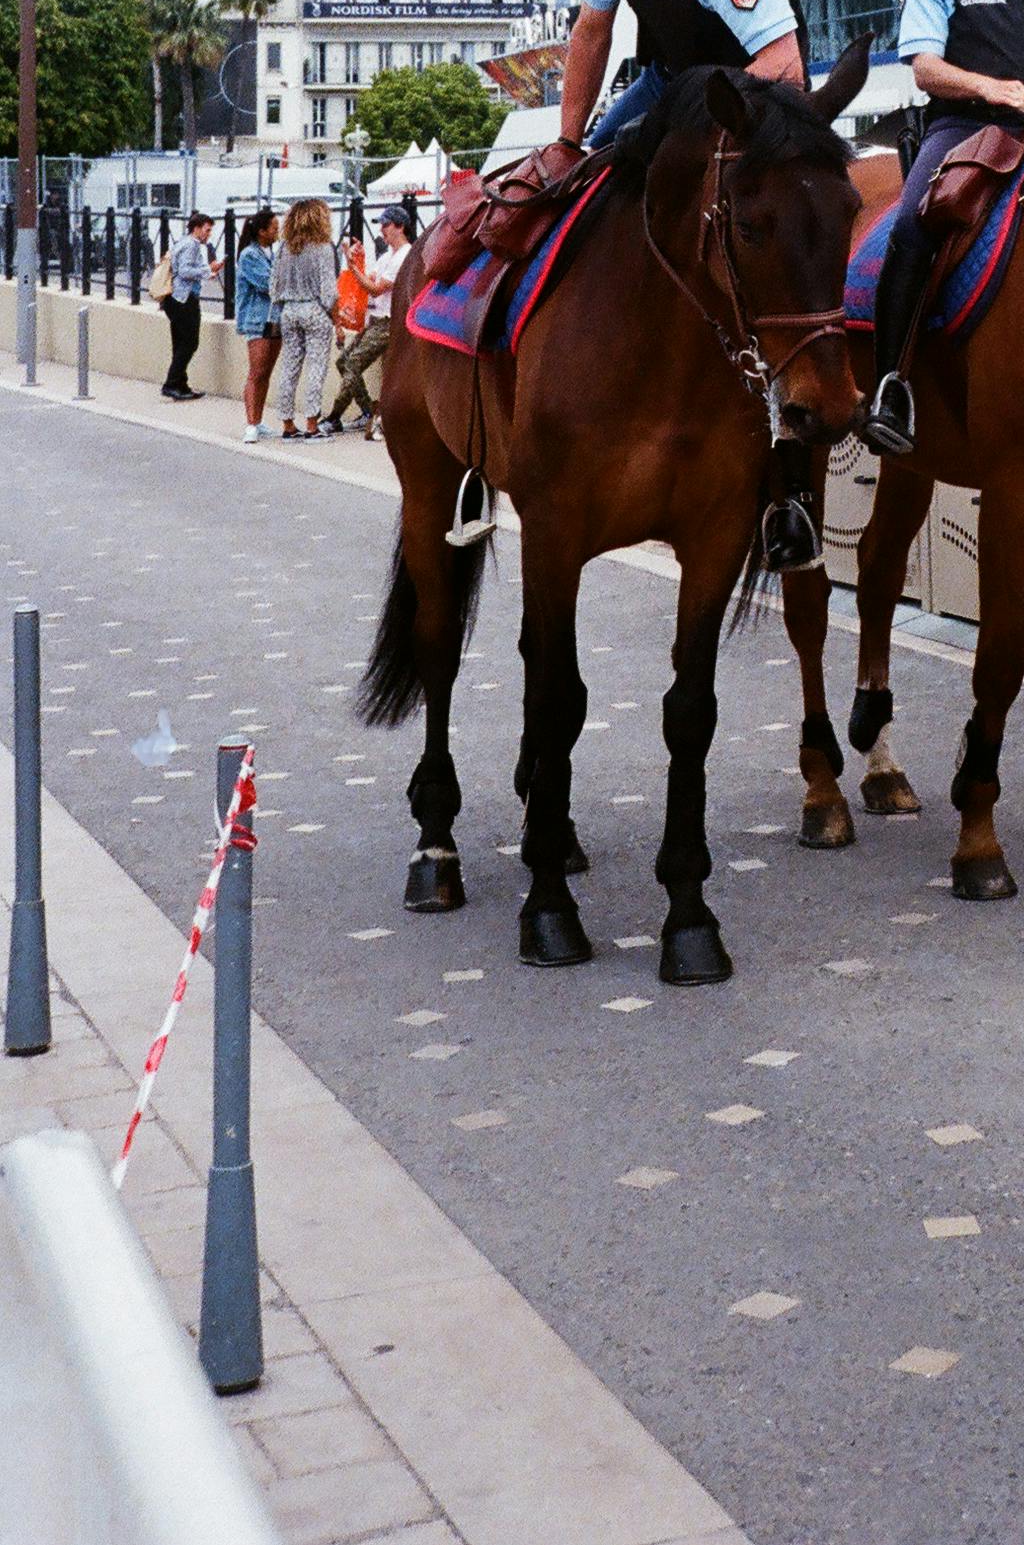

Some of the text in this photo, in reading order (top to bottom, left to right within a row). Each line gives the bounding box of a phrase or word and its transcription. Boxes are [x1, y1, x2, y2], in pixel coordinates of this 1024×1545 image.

[331, 5, 428, 16] NORDISK FILM
[451, 6, 473, 16] bring
